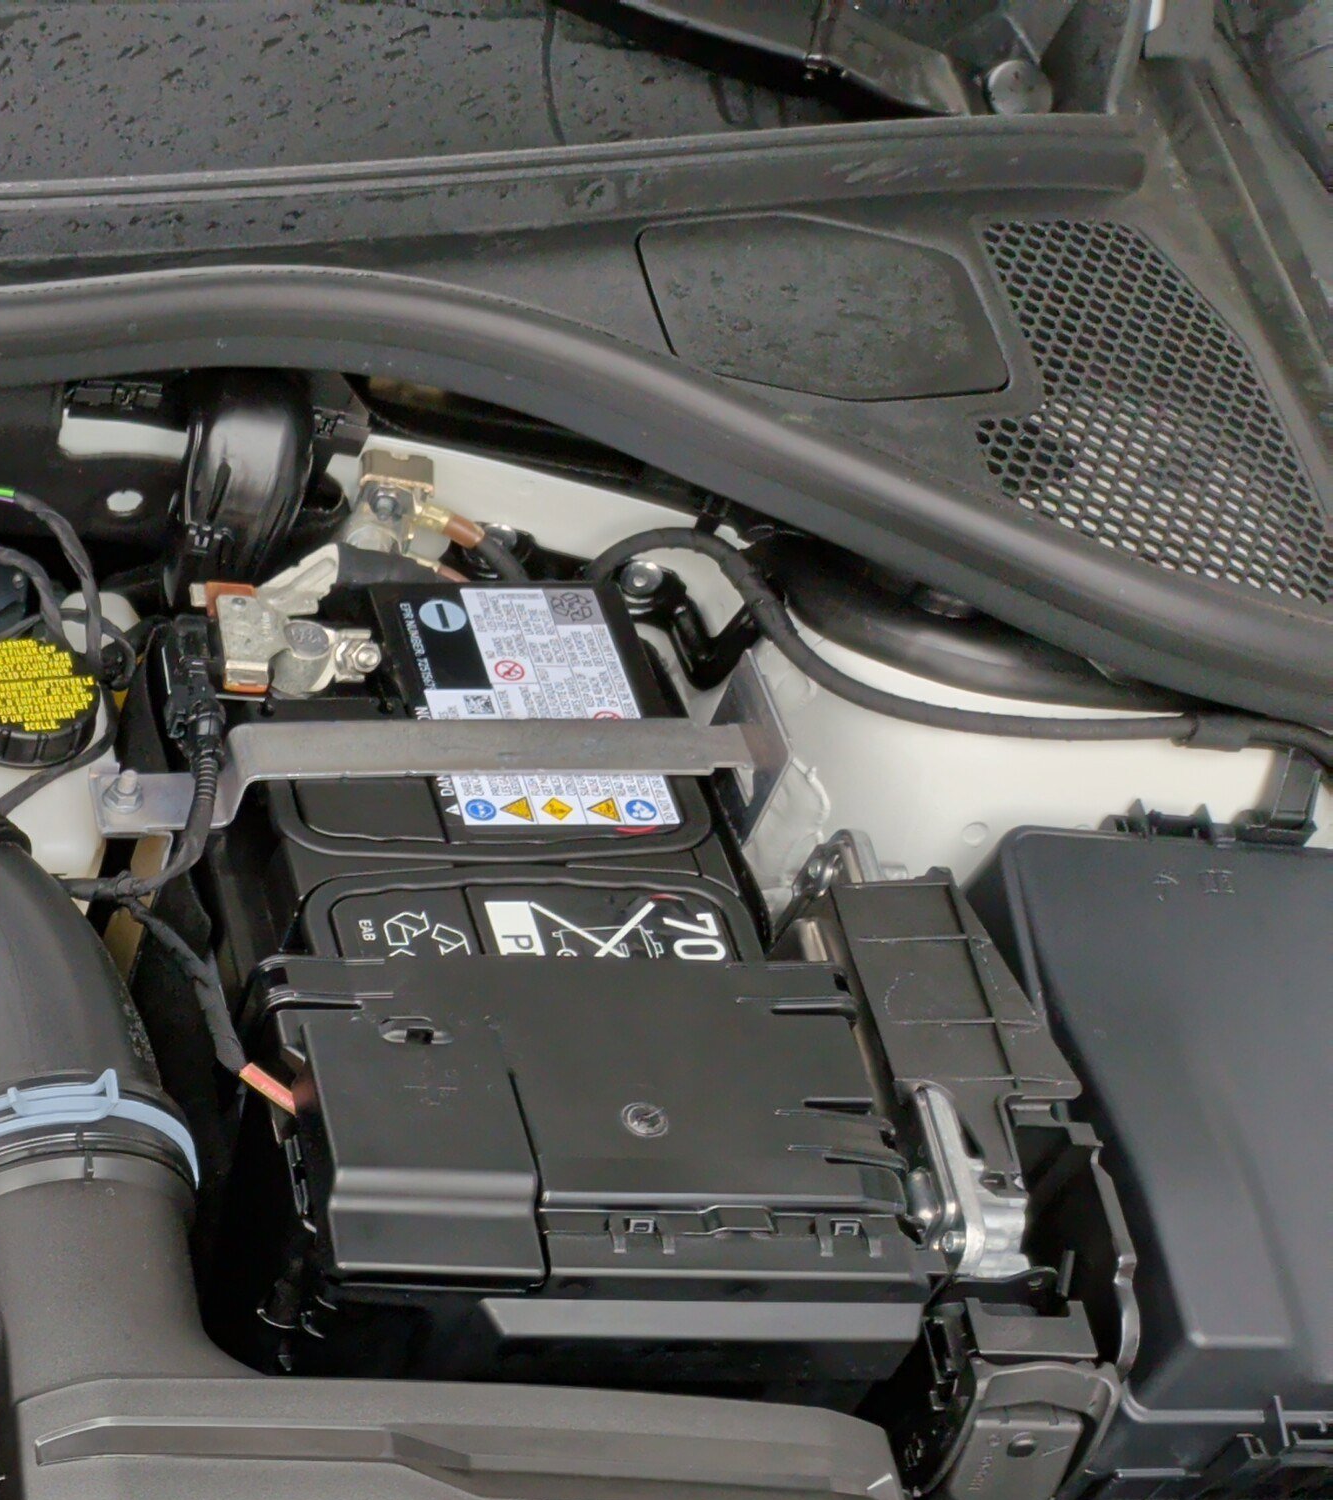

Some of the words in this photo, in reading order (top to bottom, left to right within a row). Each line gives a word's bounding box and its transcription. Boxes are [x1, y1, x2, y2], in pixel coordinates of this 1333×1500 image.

[399, 602, 415, 618] EPR
[9, 647, 37, 656] FILLER
[38, 645, 56, 654] CAP
[53, 652, 71, 661] USE
[23, 663, 48, 671] FLUID
[49, 660, 73, 669] FROM
[37, 677, 81, 688] NETTOYER
[83, 676, 94, 685] LE
[16, 688, 47, 698] AVANT
[51, 687, 61, 695] DE
[62, 694, 80, 703] QUE
[81, 693, 93, 701] DU
[40, 702, 89, 711] PROVENANT
[24, 711, 75, 721] CONTENANT
[358, 919, 376, 941] EAB
[662, 912, 726, 961] 70
